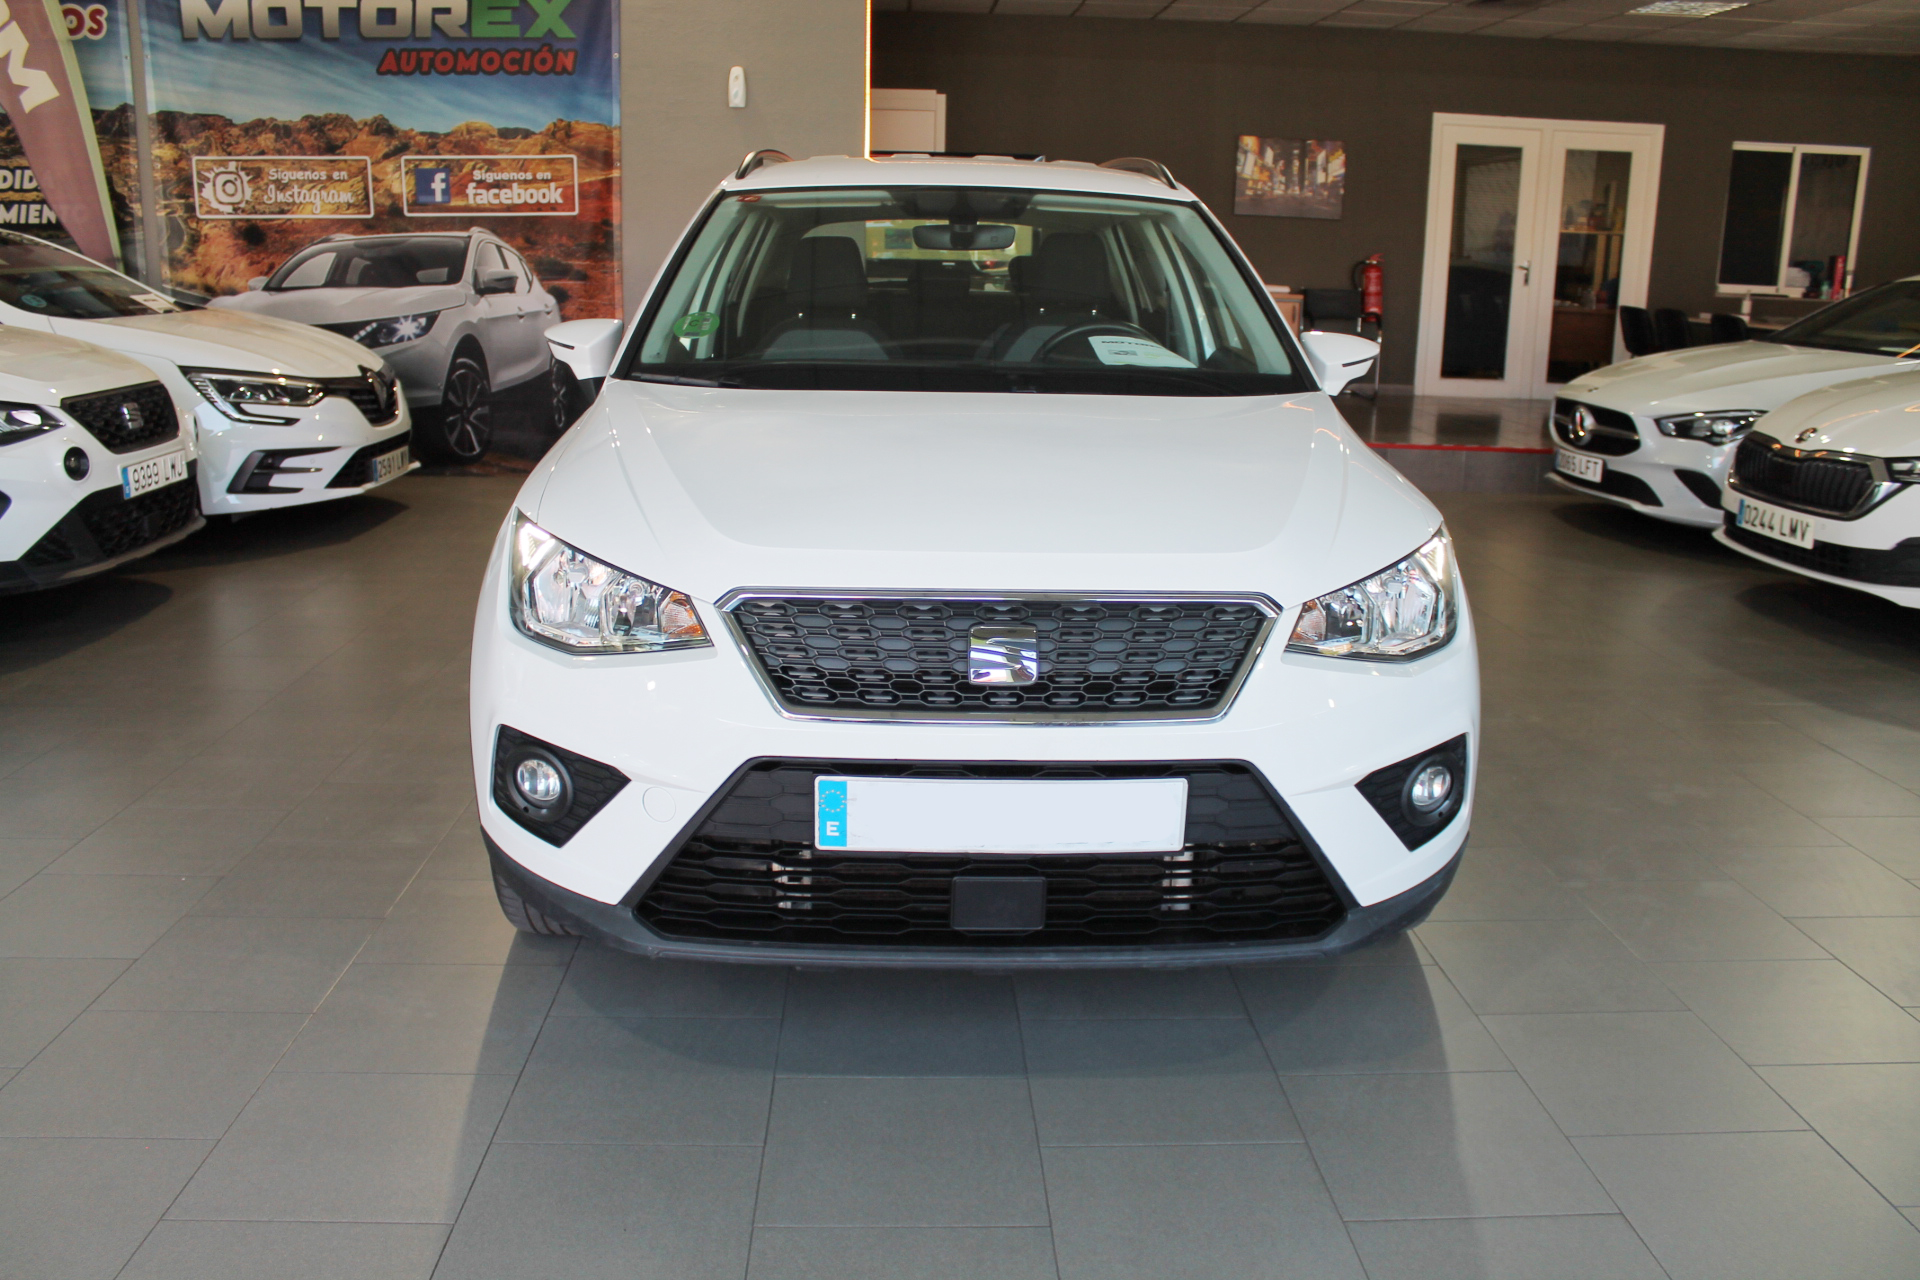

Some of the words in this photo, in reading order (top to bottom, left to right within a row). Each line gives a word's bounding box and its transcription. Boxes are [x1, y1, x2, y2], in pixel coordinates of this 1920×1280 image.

[180, 0, 577, 39] MOTOREX
[378, 45, 577, 74] AUTOMOCIÓN
[332, 171, 348, 180] en
[536, 171, 552, 180] en
[263, 184, 355, 213] Instagram
[466, 182, 564, 204] facebook
[132, 462, 160, 492] 9399
[1579, 457, 1600, 478] LFT
[1744, 504, 1775, 533] 0244
[1779, 514, 1810, 542] LMV
[826, 821, 840, 836] E
